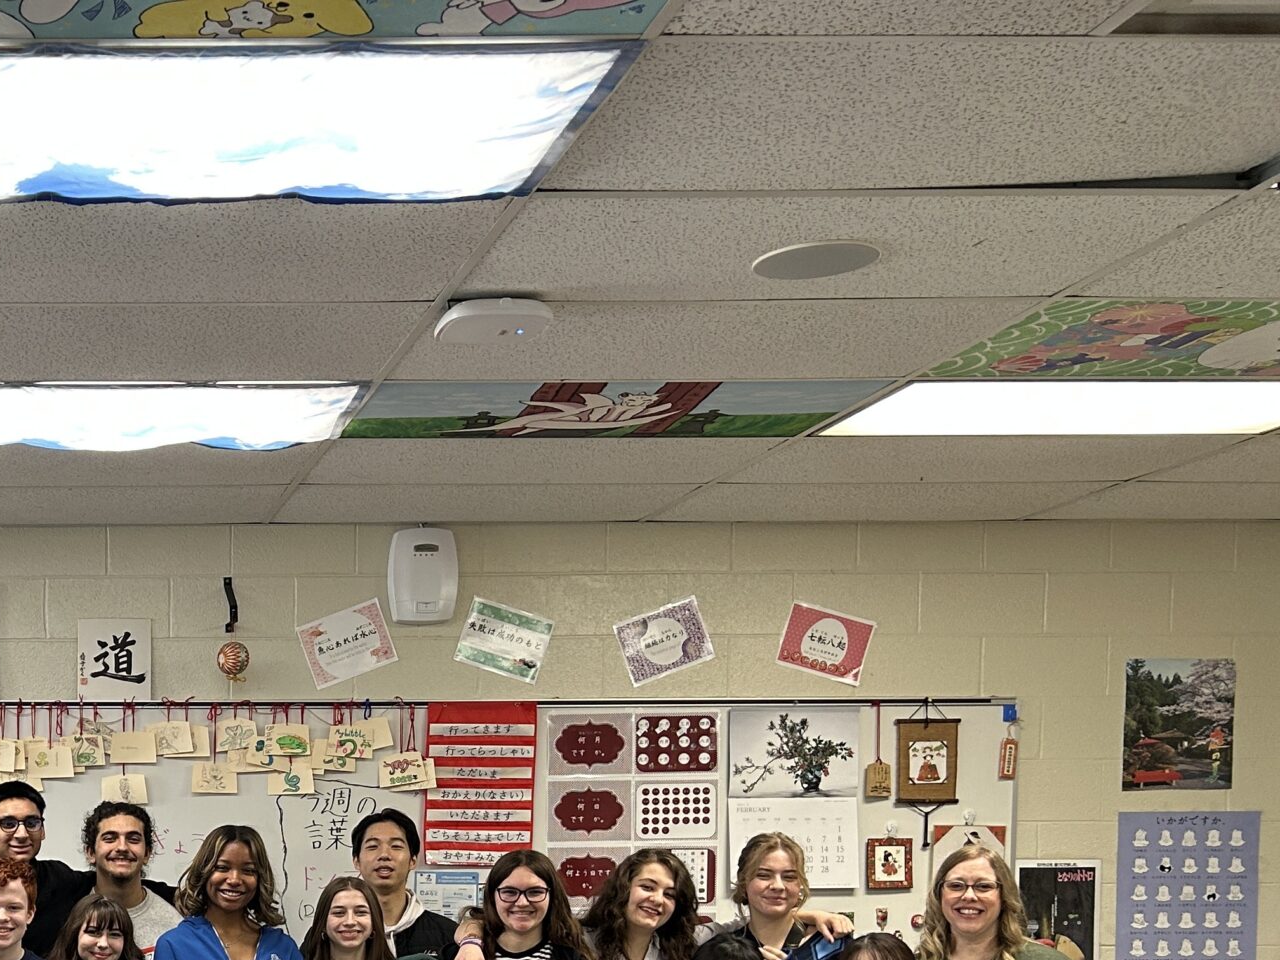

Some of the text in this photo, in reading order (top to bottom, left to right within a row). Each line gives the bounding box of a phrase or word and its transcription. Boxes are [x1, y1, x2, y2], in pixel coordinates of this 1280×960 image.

[317, 627, 377, 655] 魚心あれば水心
[468, 620, 542, 650] 失敗は成功のもと
[808, 632, 847, 652] 七転八起
[90, 631, 146, 684] 道
[448, 725, 514, 735] 行ってきます
[445, 745, 531, 756] 行ってらっしゃい
[456, 767, 498, 779] ただいま
[440, 789, 525, 800] おかえり(なさい)
[449, 811, 514, 821] いただきます
[430, 830, 526, 842] ごちそうさまでした
[565, 869, 611, 878] 何よう日です
